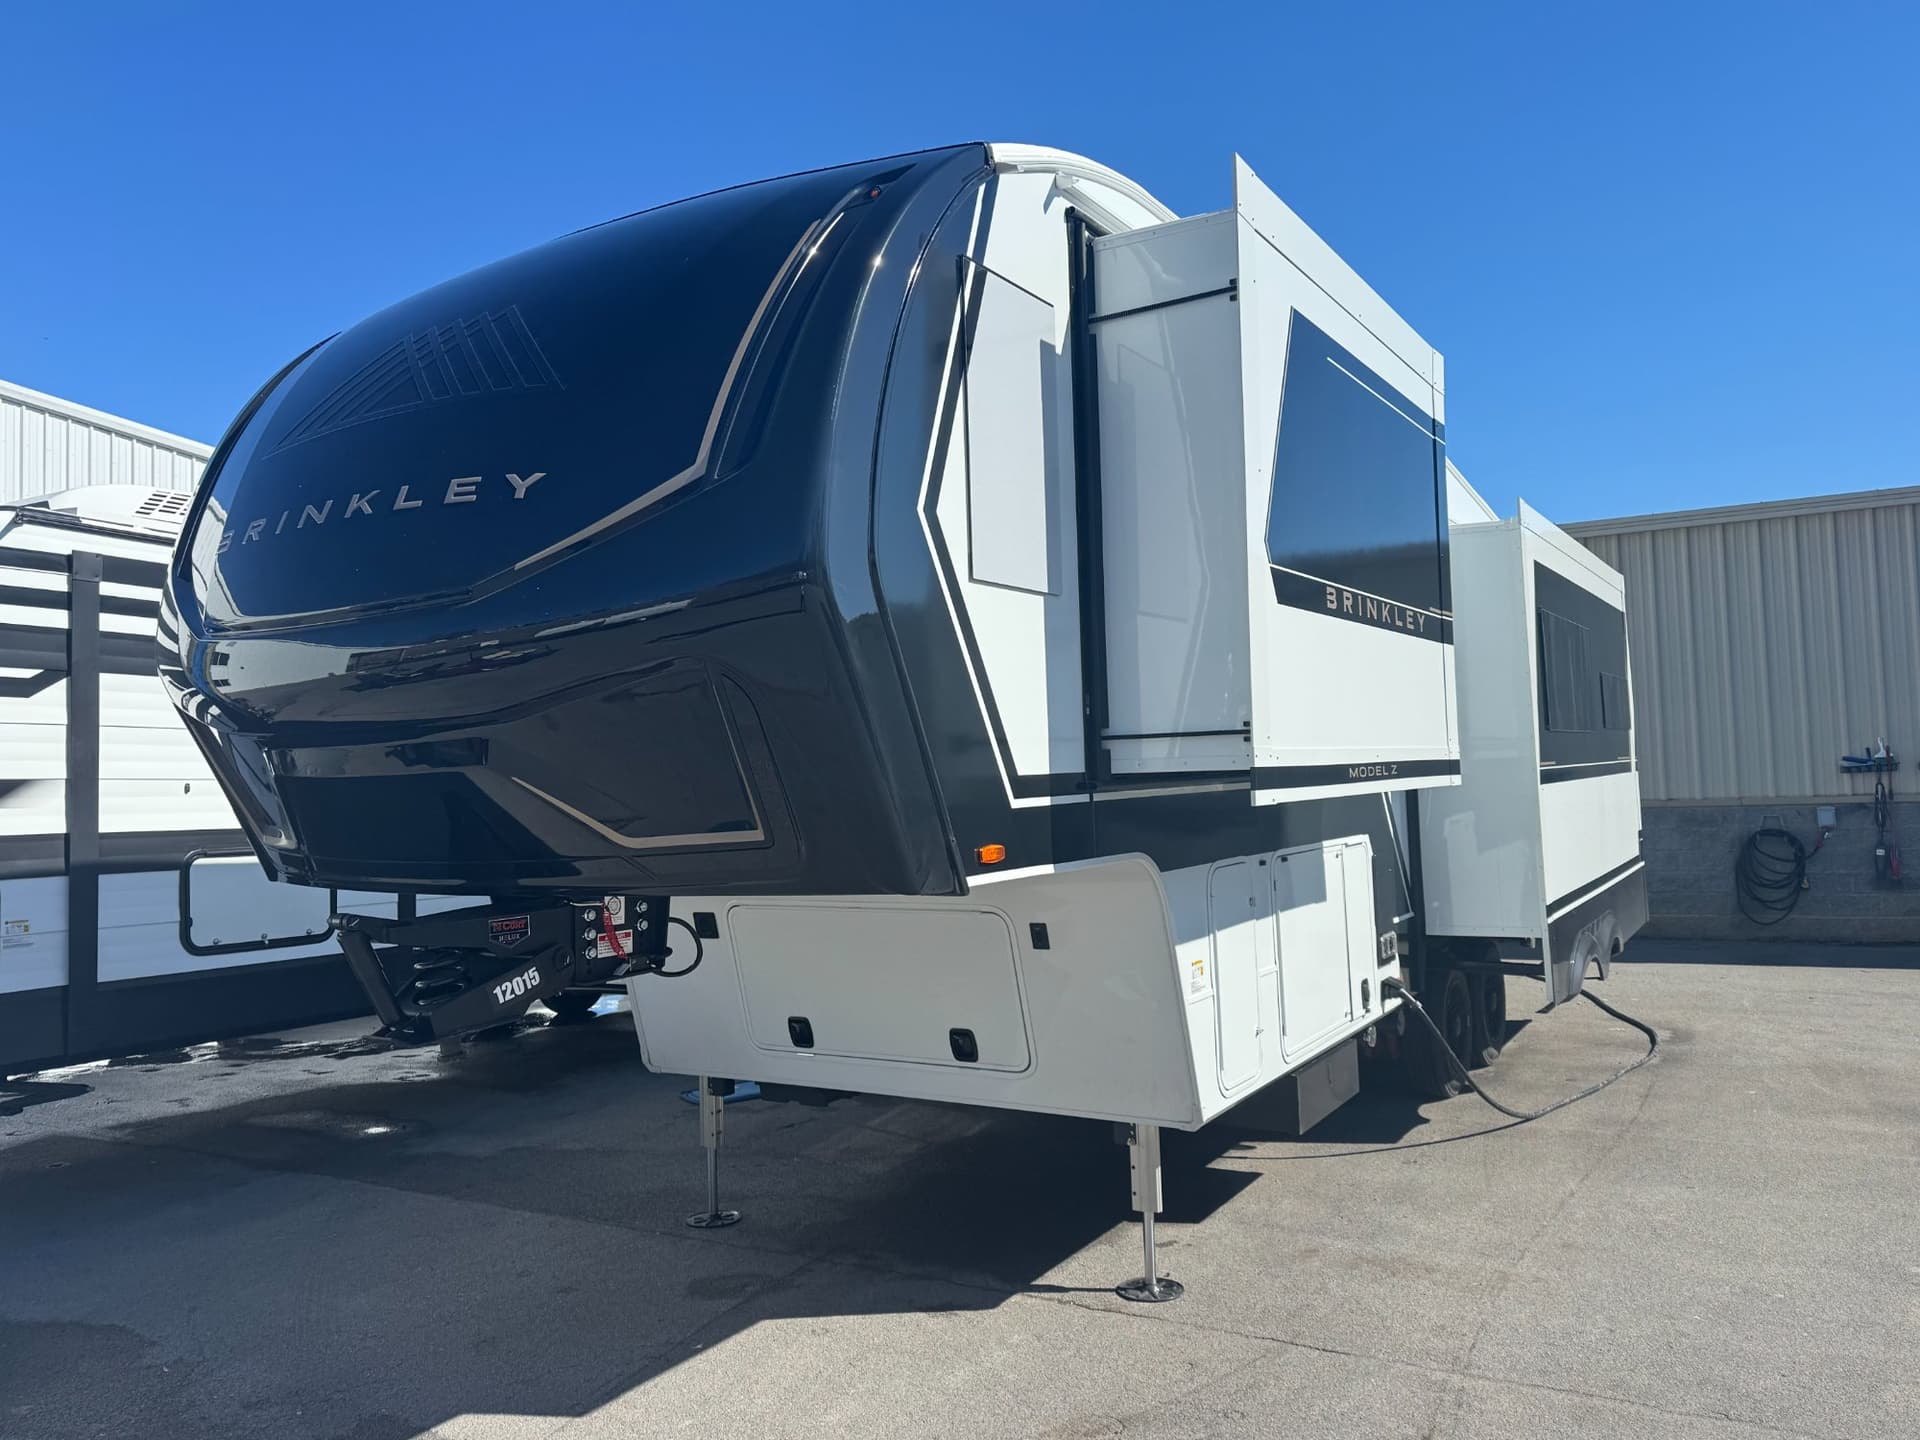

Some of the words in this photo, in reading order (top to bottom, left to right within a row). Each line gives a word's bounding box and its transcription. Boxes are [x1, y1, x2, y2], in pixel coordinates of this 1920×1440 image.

[217, 472, 547, 554] BRINKLEY
[1326, 586, 1425, 633] BRINKLEY
[1349, 764, 1389, 779] MODEL
[1390, 764, 1398, 775] Z
[493, 966, 541, 1004] 12015
